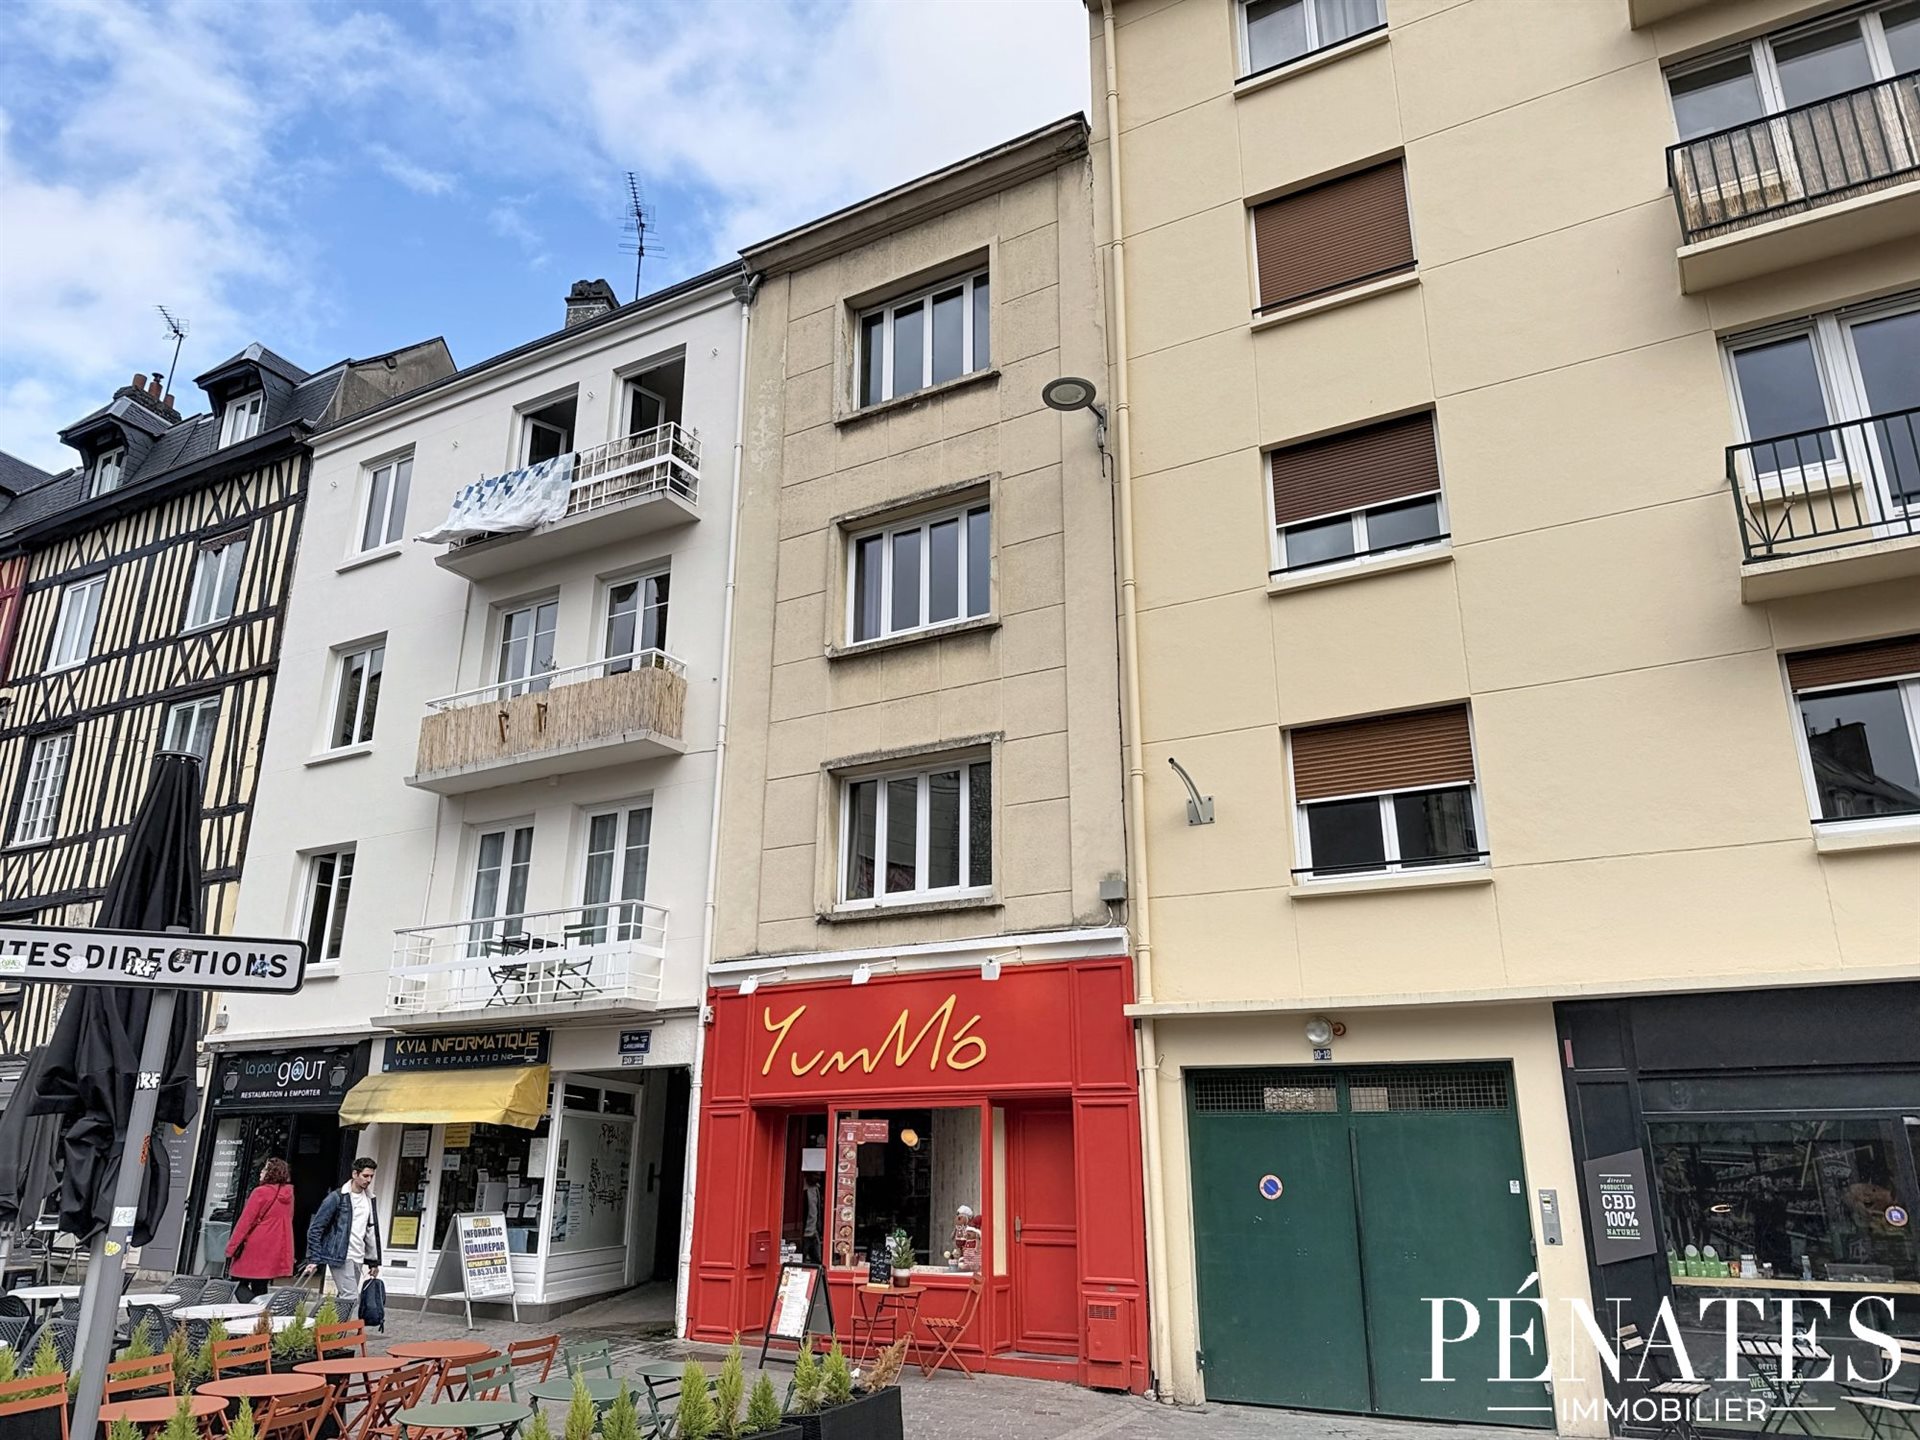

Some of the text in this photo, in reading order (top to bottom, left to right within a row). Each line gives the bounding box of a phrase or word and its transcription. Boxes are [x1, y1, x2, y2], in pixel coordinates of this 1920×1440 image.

[396, 1031, 540, 1054] KVIA INFORMATIQUE
[395, 1057, 429, 1066] VENTE
[240, 1090, 283, 1099] RESTAURATION
[289, 1089, 320, 1097] EMPORTER
[1602, 1194, 1636, 1209] CBD
[1604, 1211, 1639, 1227] 100%
